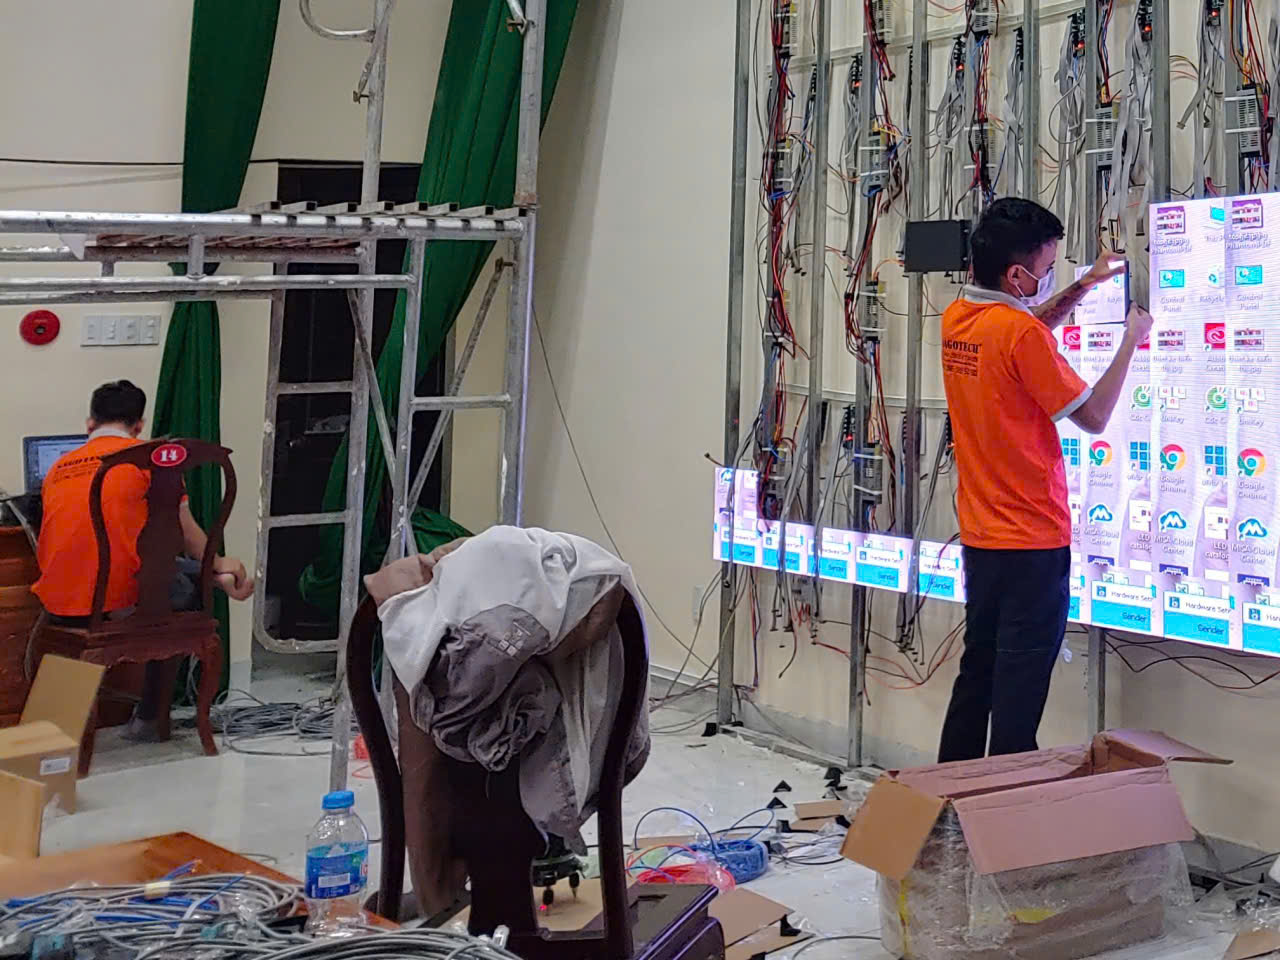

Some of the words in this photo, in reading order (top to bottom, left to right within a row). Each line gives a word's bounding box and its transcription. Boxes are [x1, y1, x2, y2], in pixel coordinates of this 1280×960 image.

[160, 449, 178, 462] 14
[1121, 612, 1146, 622] Sender
[1197, 624, 1224, 635] Sender
